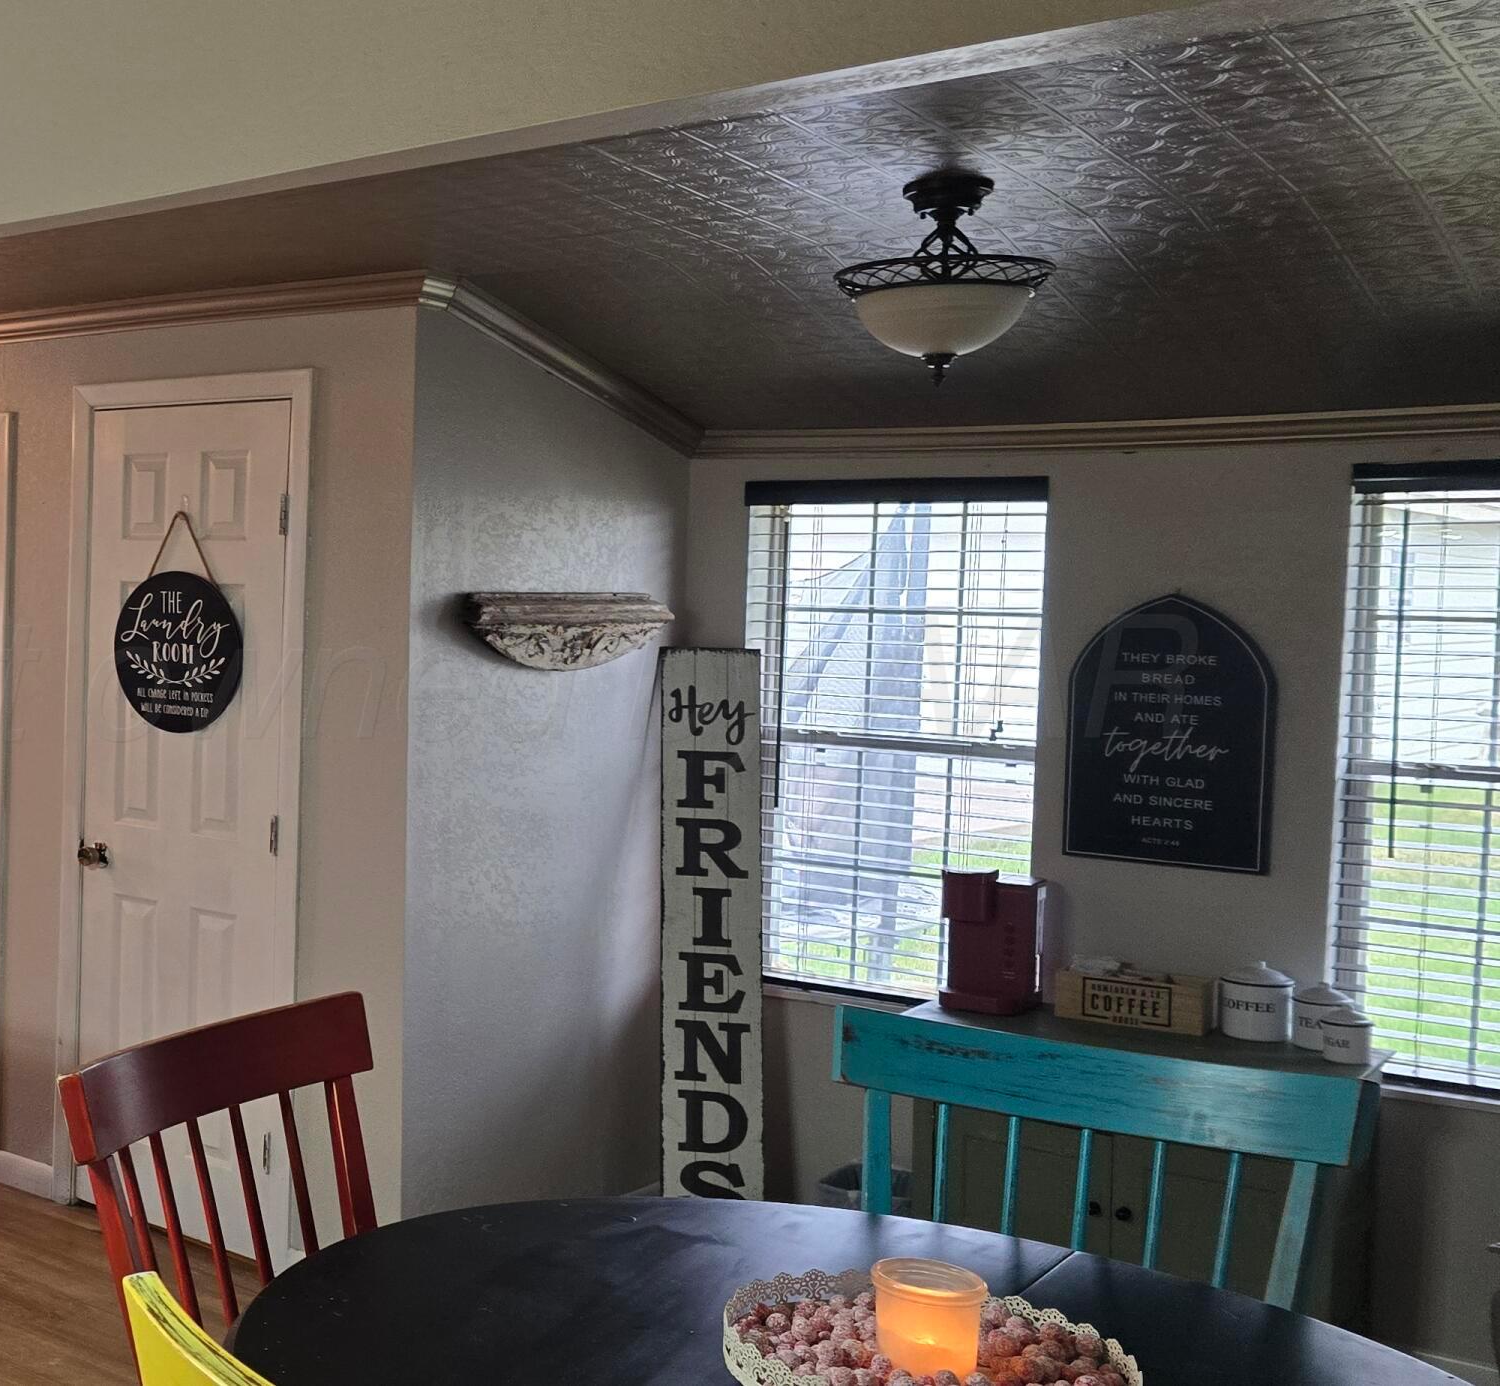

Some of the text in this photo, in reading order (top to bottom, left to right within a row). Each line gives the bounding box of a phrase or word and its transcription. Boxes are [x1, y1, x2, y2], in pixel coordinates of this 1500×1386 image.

[160, 591, 182, 614] THE
[120, 593, 230, 658] Laundry
[152, 641, 194, 664] ROOM
[1122, 652, 1218, 666] THEY BROKE
[1141, 673, 1196, 685] BREAD
[1114, 691, 1222, 706] IN THEIR HOMES
[668, 685, 756, 745] Hey
[1134, 712, 1199, 725] AND ATE
[1102, 726, 1230, 772] together
[1123, 773, 1205, 789] WITH GLAD
[1113, 792, 1213, 811] AND SINCERE
[1131, 815, 1194, 830] HEARTS
[674, 750, 750, 1200] FRIENDS
[1091, 993, 1161, 1018] COFFEE
[1222, 997, 1276, 1013] COFFEE
[1298, 1016, 1323, 1029] TEA
